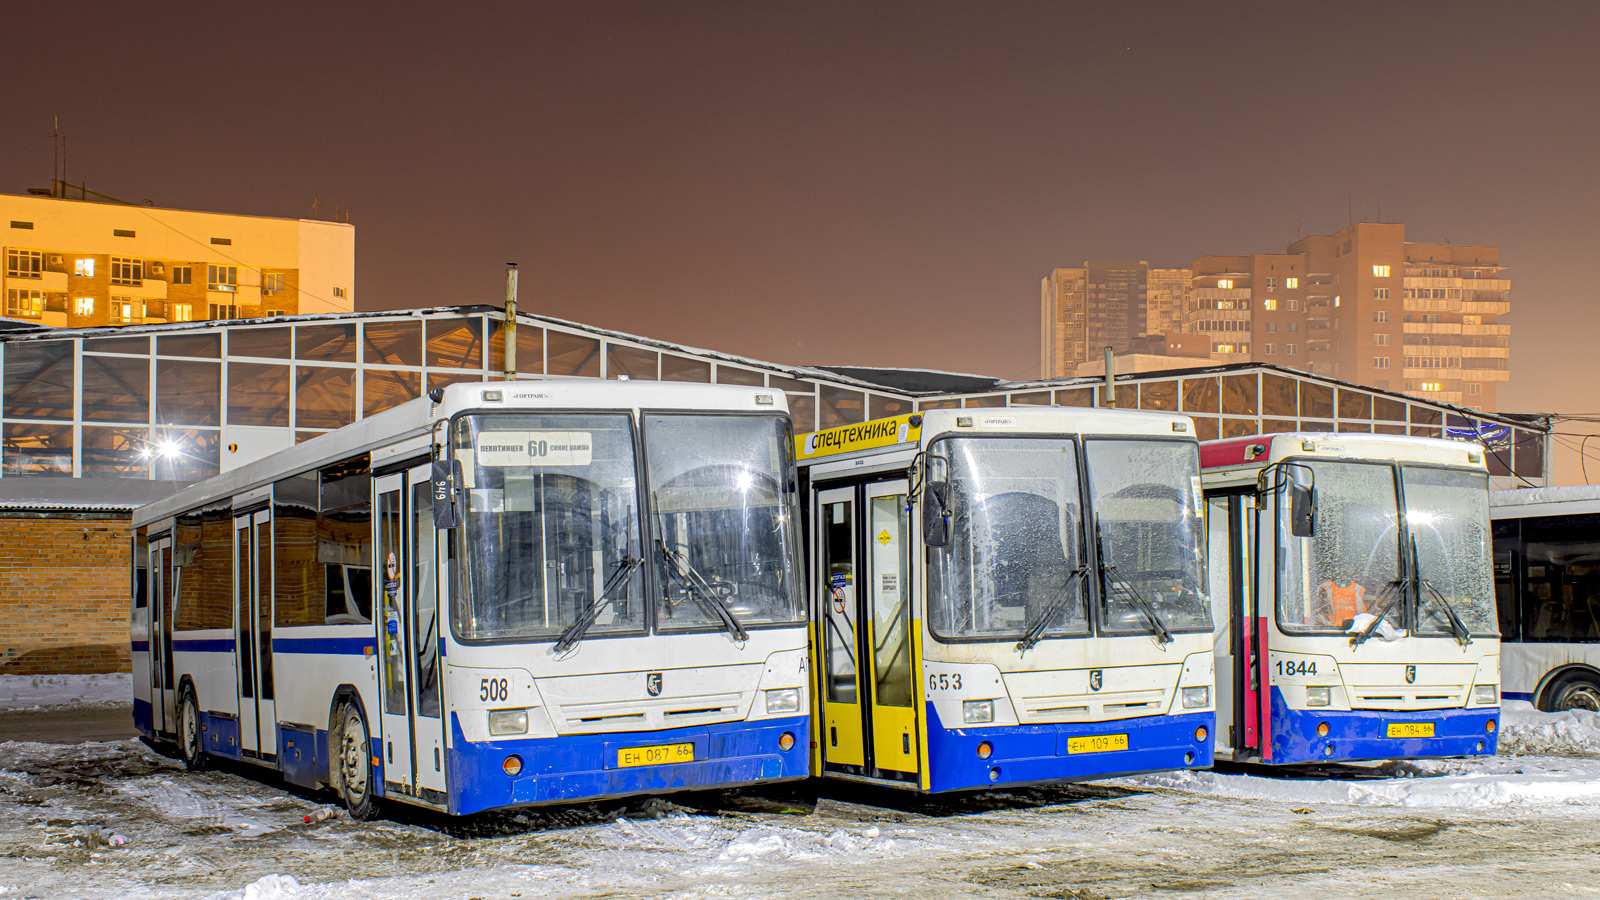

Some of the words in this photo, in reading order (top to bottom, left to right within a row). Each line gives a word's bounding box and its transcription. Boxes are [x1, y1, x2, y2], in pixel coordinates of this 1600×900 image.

[811, 420, 897, 450] спецтехника
[480, 445, 524, 453] ПЕХОТИНЦЕВ
[527, 440, 548, 457] 60
[1275, 660, 1318, 676] 1844
[480, 677, 508, 702] 508
[929, 672, 963, 691] 653
[1405, 724, 1420, 736] 084
[1091, 737, 1109, 750] 109
[1114, 735, 1125, 745] 66
[646, 747, 669, 762] 087
[677, 745, 689, 756] 66
